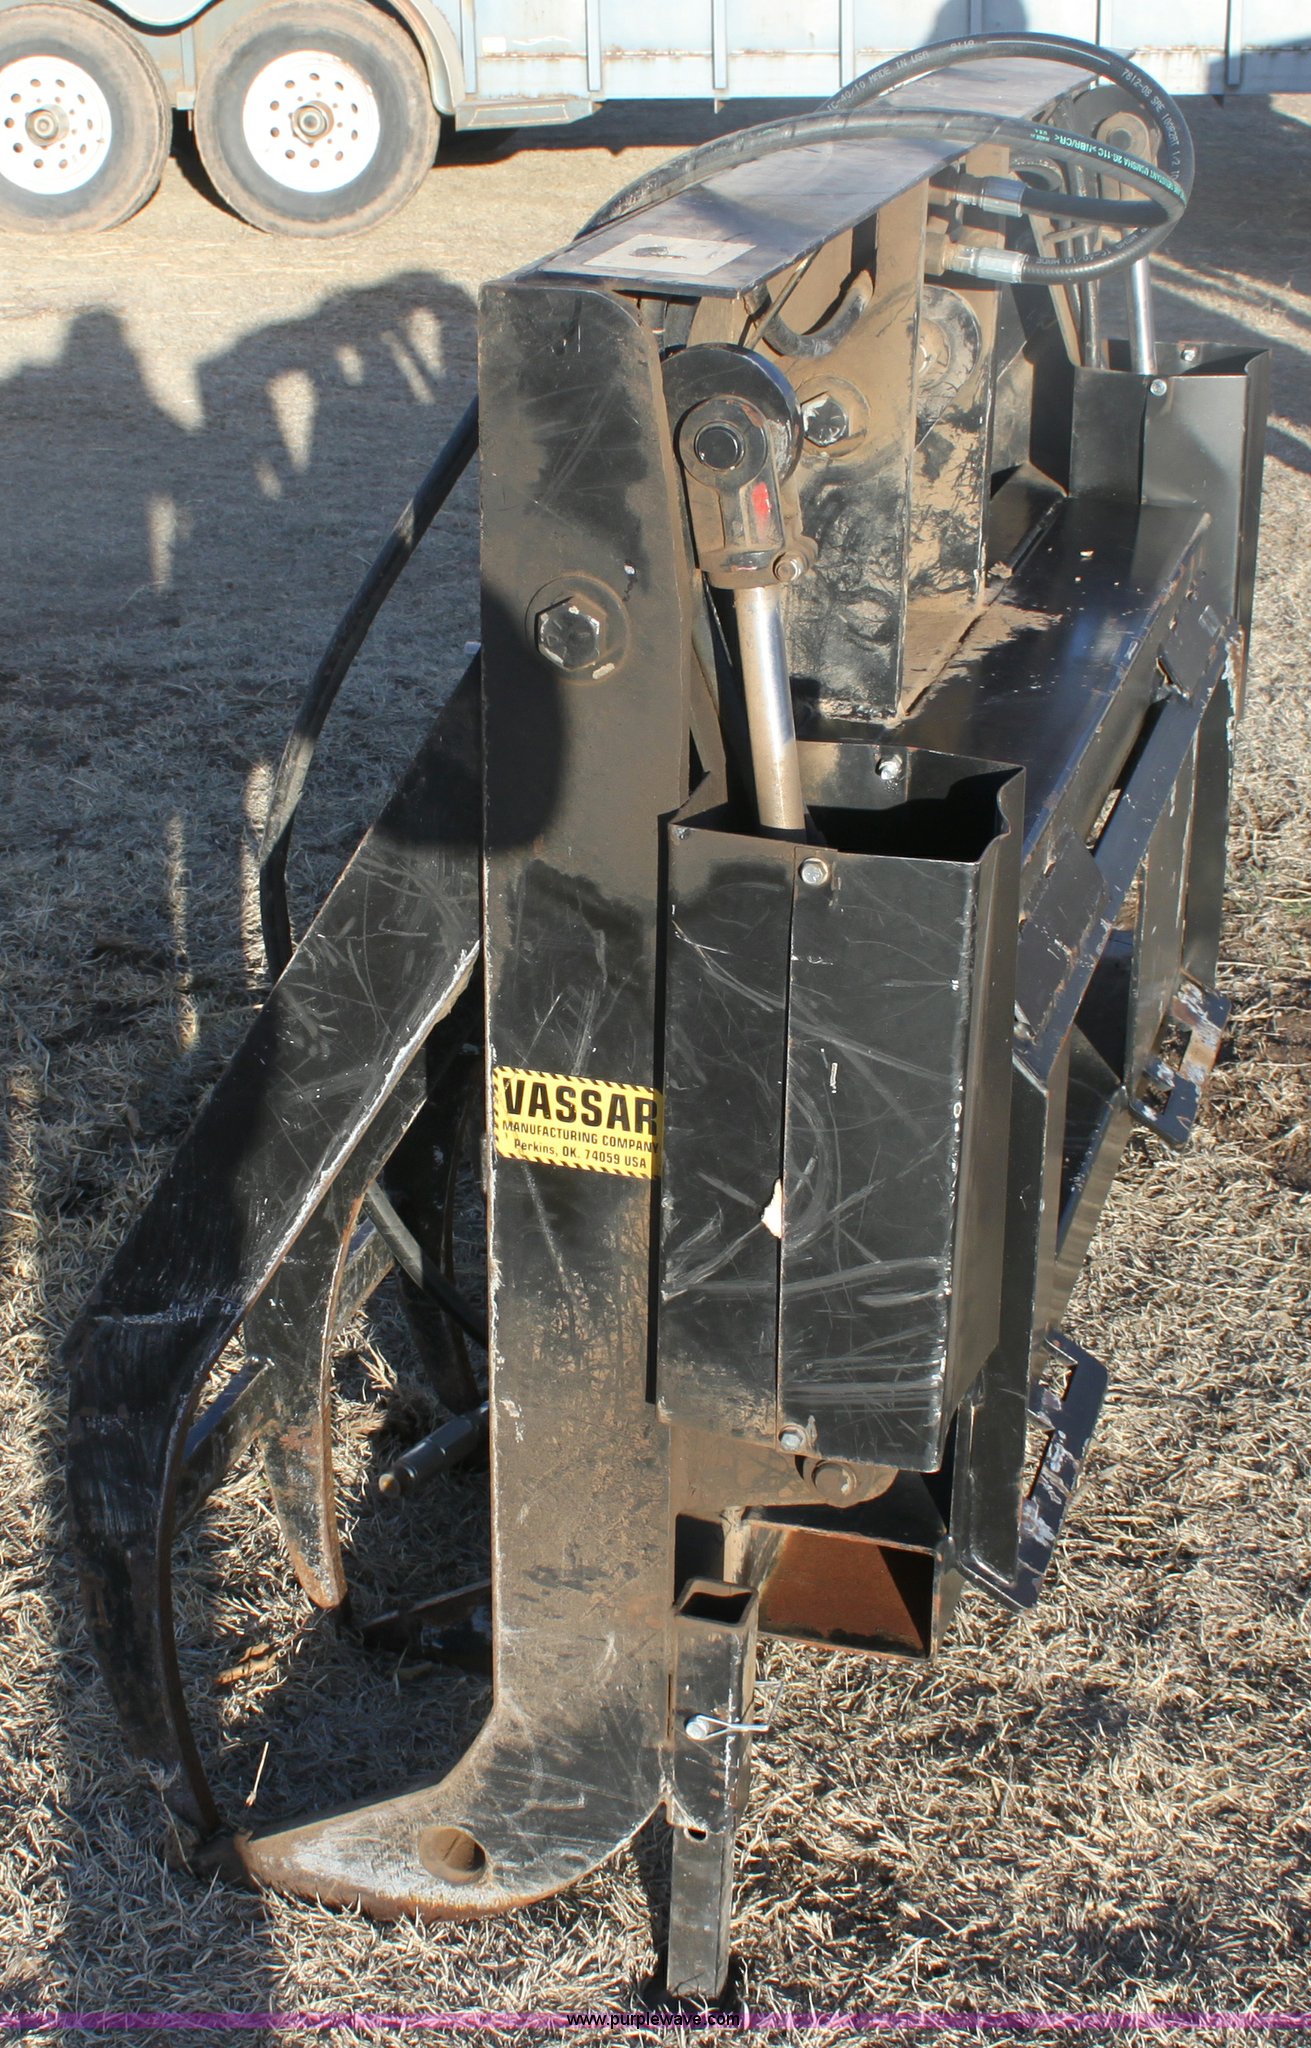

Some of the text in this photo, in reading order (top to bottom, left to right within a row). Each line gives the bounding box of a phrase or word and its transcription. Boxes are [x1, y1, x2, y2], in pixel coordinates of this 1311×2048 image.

[869, 67, 892, 85] MADE
[896, 59, 908, 70] IN
[910, 51, 929, 63] USA
[1150, 96, 1165, 112] SAE
[502, 1077, 658, 1136] VASSAR
[503, 1121, 660, 1154] MANUFACTURING COMPANY
[514, 1139, 647, 1169] Perkins, OK. 74059 USA
